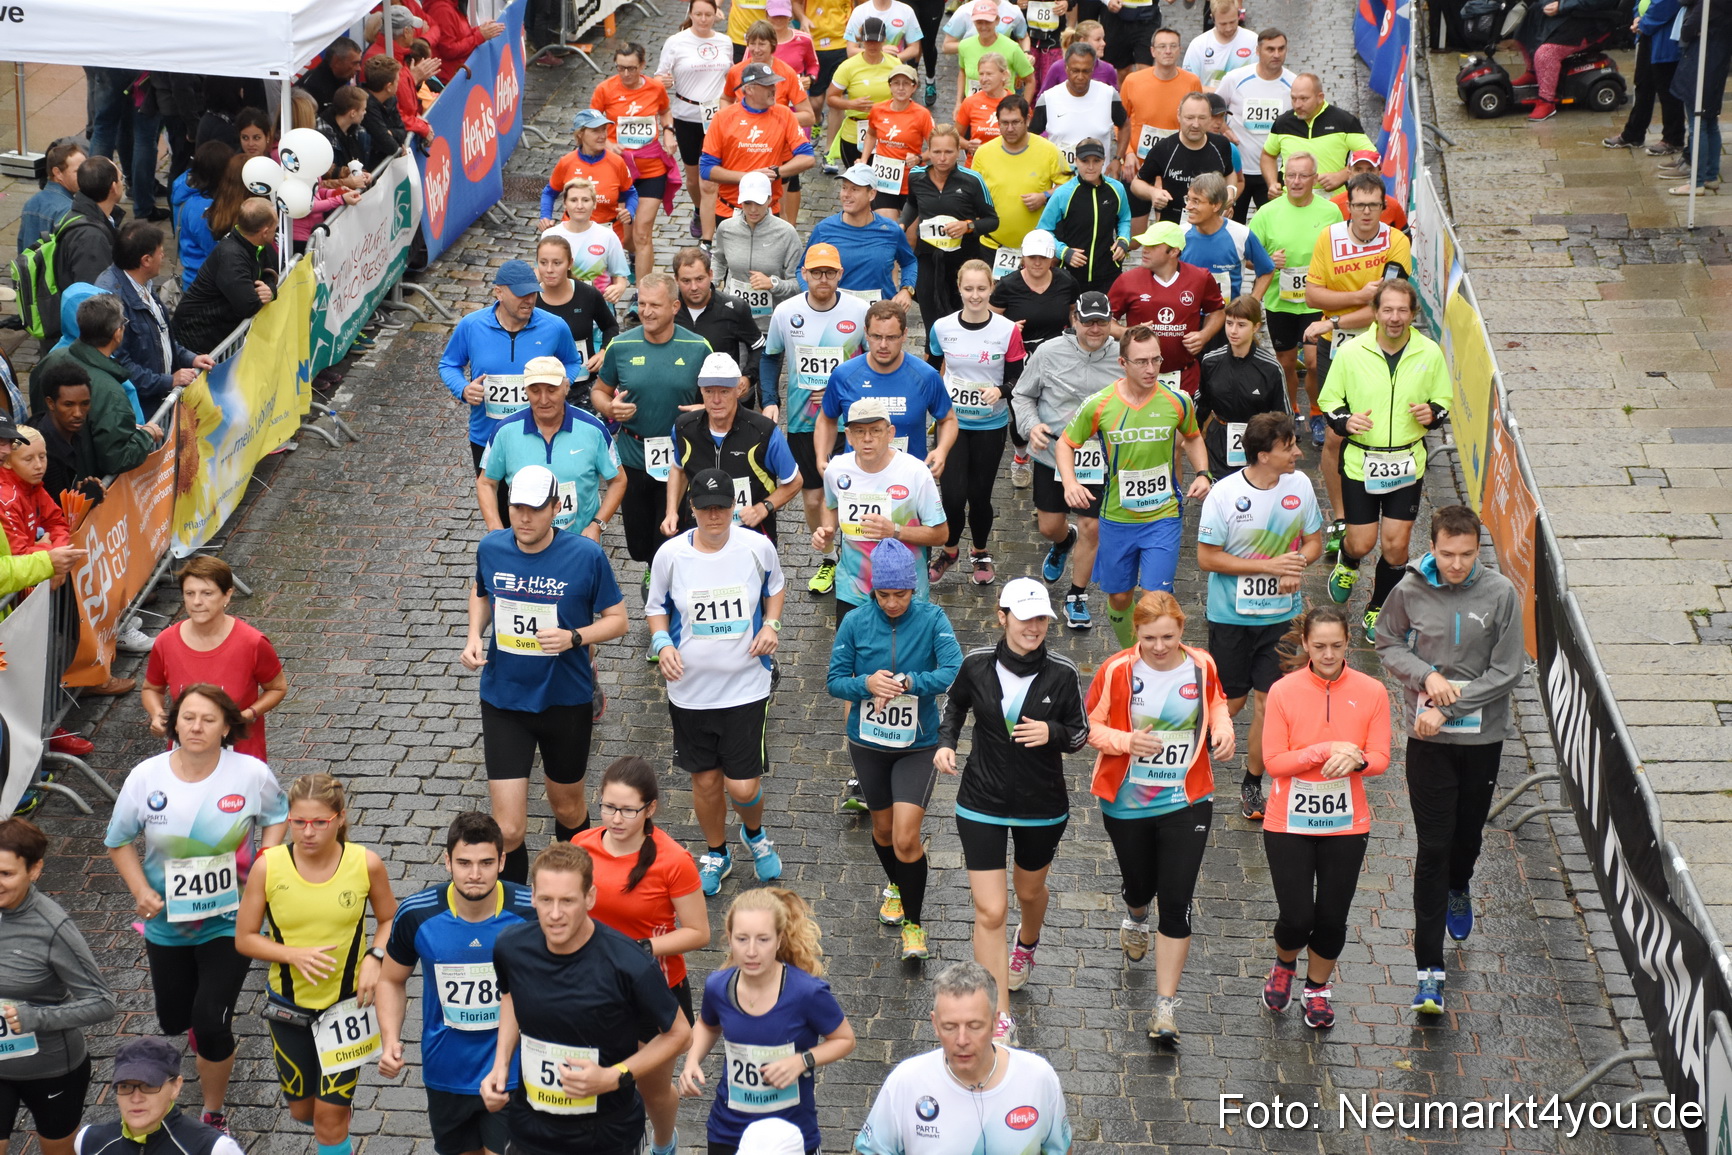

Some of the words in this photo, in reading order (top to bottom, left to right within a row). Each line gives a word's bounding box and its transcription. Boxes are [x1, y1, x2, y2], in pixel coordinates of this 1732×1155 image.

[1037, 8, 1051, 21] 68
[495, 62, 519, 117] Hervis
[1246, 107, 1279, 121] 2913
[462, 102, 496, 166] Hervis
[620, 122, 653, 136] 2625
[738, 141, 769, 149] funrunners
[425, 154, 450, 223] Hervis
[998, 252, 1022, 269] 24
[1333, 262, 1362, 276] MAX
[800, 357, 840, 374] 2612
[807, 377, 829, 385] Thoma
[955, 407, 980, 415] Hannah
[1107, 426, 1172, 444] BOCK
[1368, 460, 1410, 478] 2337
[1125, 475, 1168, 497] 2859
[1380, 479, 1402, 488] Stefan
[1136, 498, 1159, 506] Tobias
[528, 576, 569, 590] HiRo
[1243, 577, 1285, 596] 308
[527, 587, 546, 595] Run
[694, 597, 743, 622] 2111
[513, 614, 538, 636] 54
[709, 624, 732, 634] Tanja
[515, 639, 536, 650] Sven
[872, 727, 901, 740] Claudia
[1147, 769, 1177, 779] Andrea
[1294, 792, 1348, 815] 2564
[1307, 818, 1334, 827] Katrin
[173, 867, 232, 897] 2400
[192, 899, 217, 912] Mara
[460, 1011, 497, 1022] Florian
[328, 1011, 371, 1045] 181
[335, 1042, 373, 1062] Christina
[744, 1092, 779, 1104] Miriam
[1009, 1112, 1036, 1126] Hervis
[915, 1124, 940, 1134] PARTL
[916, 1131, 940, 1140] Neumarkt
